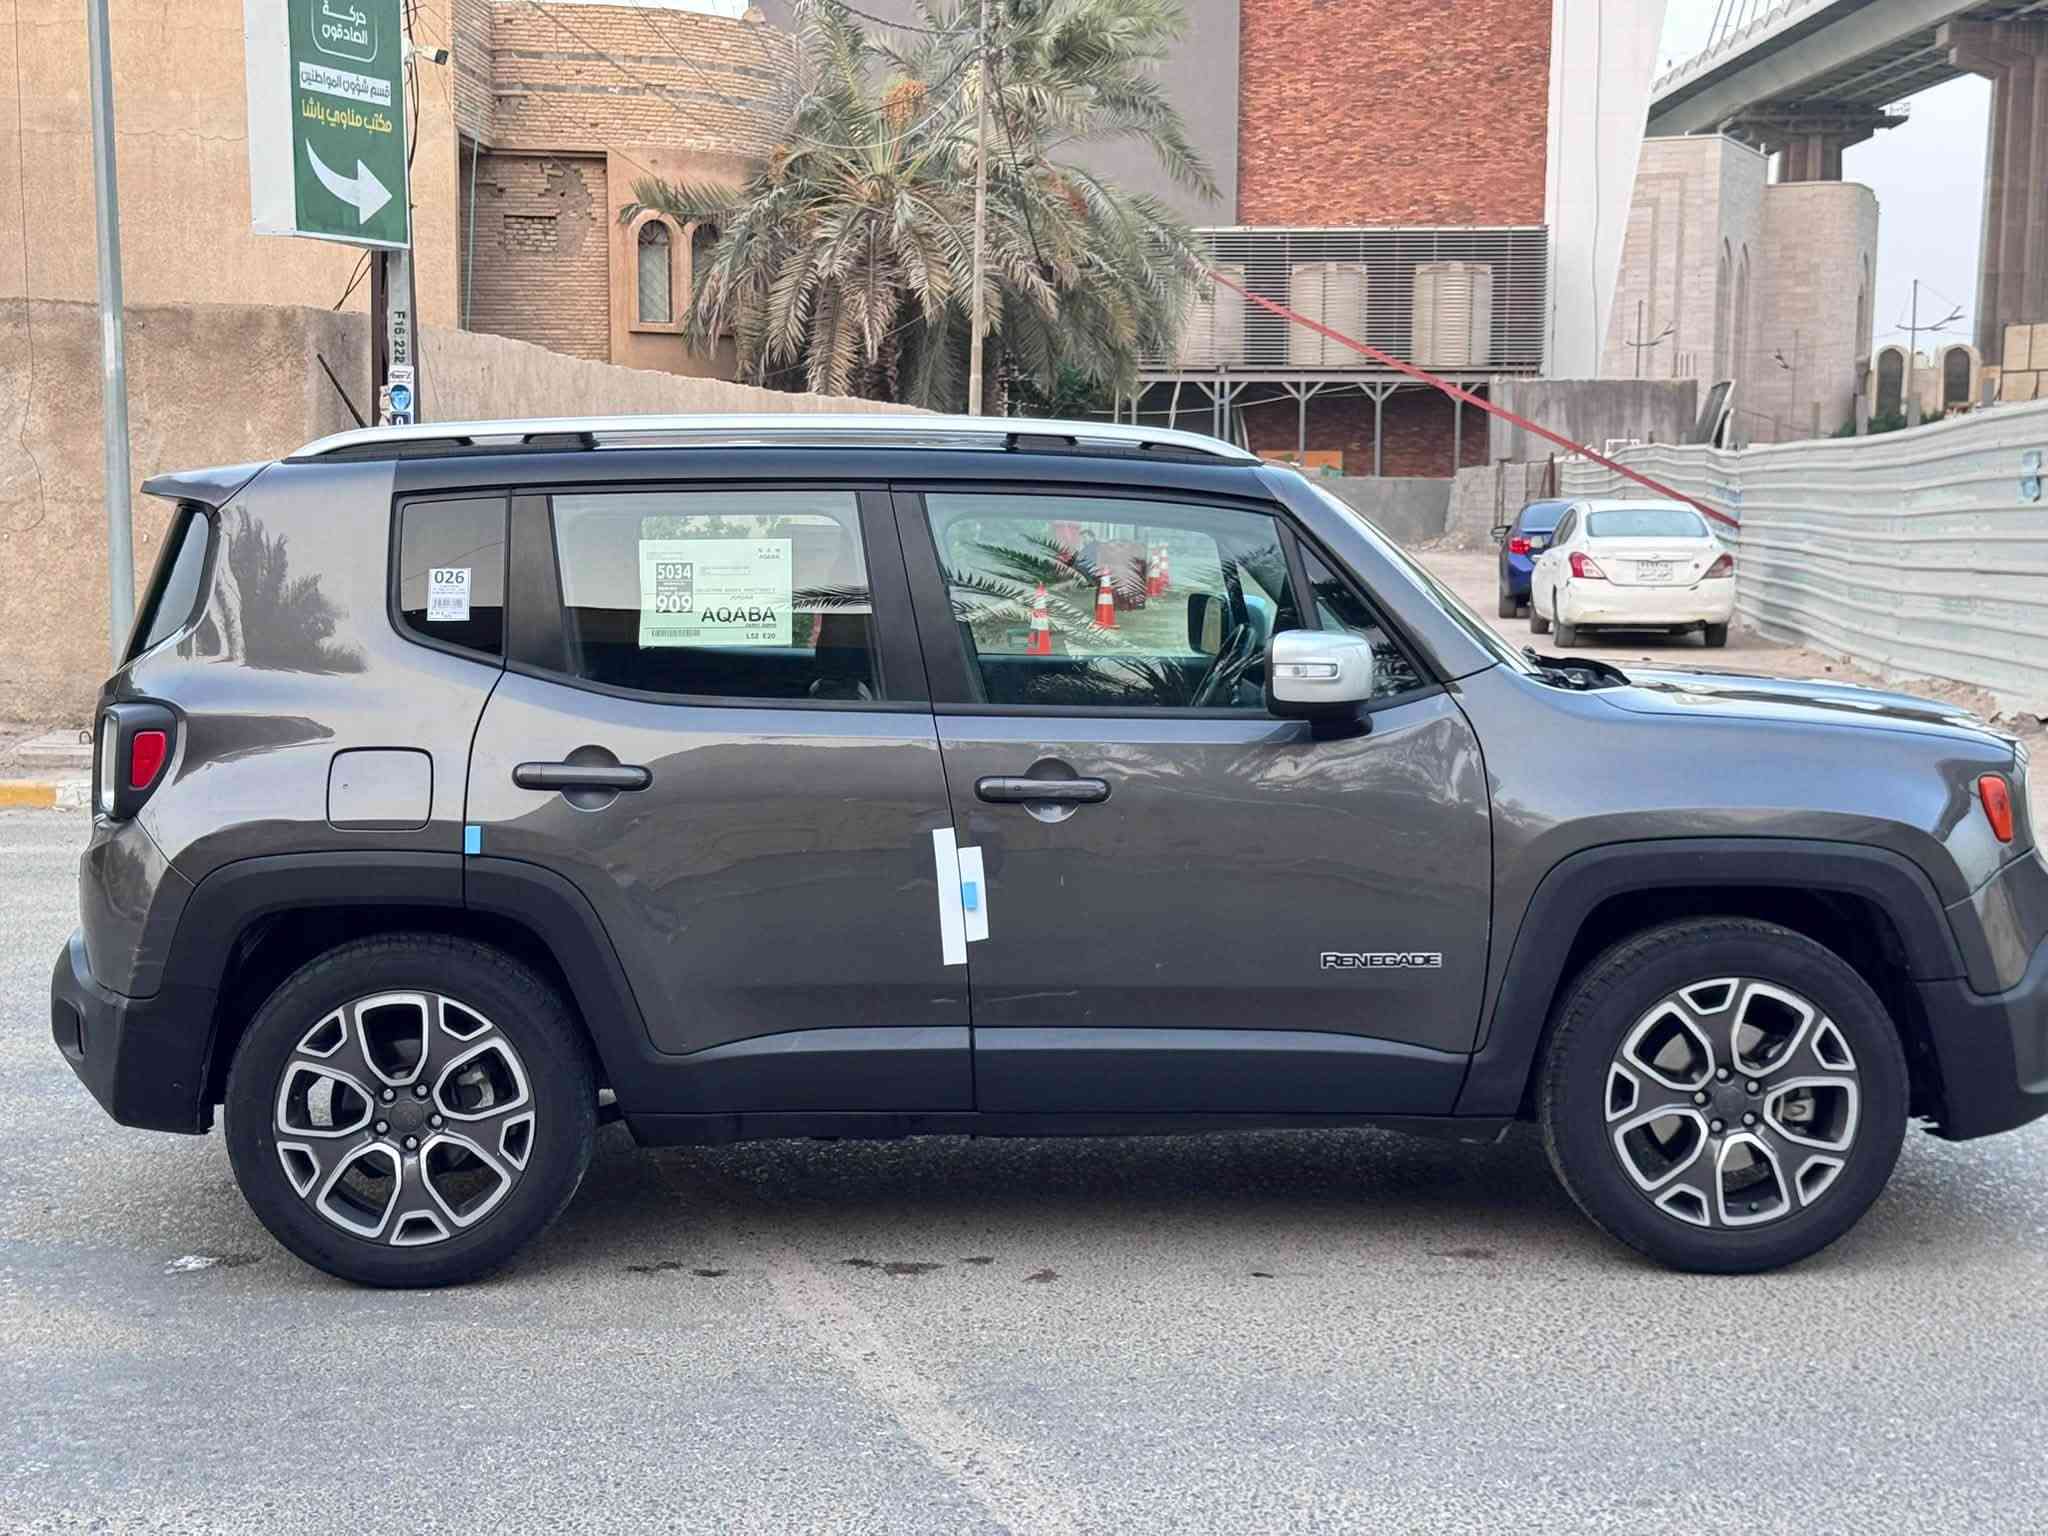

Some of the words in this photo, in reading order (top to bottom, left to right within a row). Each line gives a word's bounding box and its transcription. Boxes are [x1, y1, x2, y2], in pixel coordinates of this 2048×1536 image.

[322, 23, 368, 45] الصادقون
[301, 68, 342, 90] المواطنين
[343, 76, 369, 96] شؤون
[370, 84, 391, 98] قسم
[302, 97, 325, 125] باشا
[326, 106, 362, 130] مناوي
[364, 111, 392, 133] مكتب
[434, 570, 465, 584] 026
[657, 564, 692, 578] 5034
[656, 595, 692, 613] 909
[701, 607, 777, 624] AQABA
[1320, 952, 1442, 969] RENEGADE
